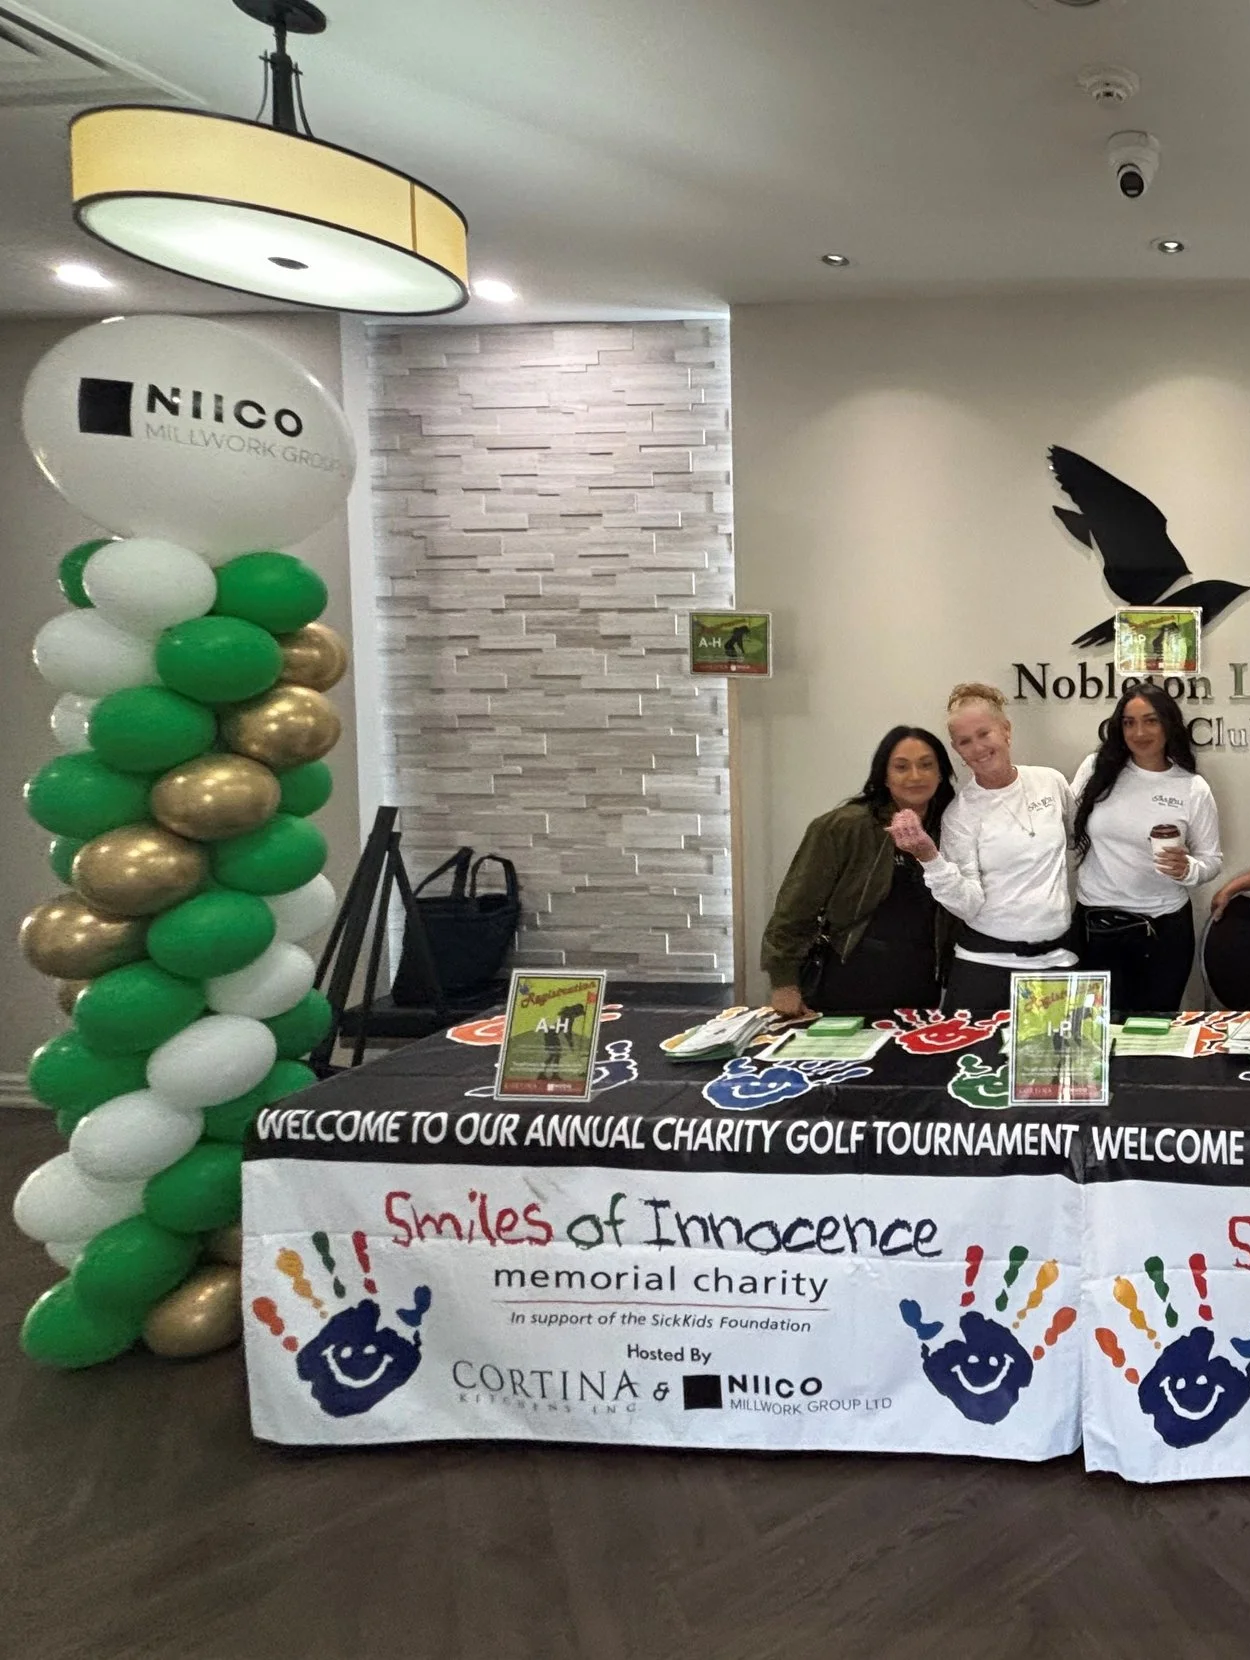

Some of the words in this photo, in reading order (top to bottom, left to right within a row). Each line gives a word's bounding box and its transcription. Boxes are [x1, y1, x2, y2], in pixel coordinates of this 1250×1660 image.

[146, 383, 304, 438] NIICO
[145, 422, 277, 458] MILLWORK
[698, 637, 722, 648] A-H
[535, 1018, 570, 1034] A-H
[256, 1108, 408, 1143] WELCOME
[411, 1111, 449, 1144] TO
[454, 1112, 521, 1146] OUR
[524, 1114, 645, 1149] ANNUAL
[652, 1117, 783, 1153] CHARITY
[785, 1120, 867, 1154] GOLF
[872, 1121, 1079, 1158] TOURNAMENT
[1092, 1126, 1245, 1166] WELCOME
[385, 1188, 554, 1247] Smiles
[567, 1192, 627, 1250] of
[638, 1196, 943, 1257] Innocence
[494, 1266, 676, 1290] memorial
[693, 1267, 829, 1303] charity
[511, 1312, 525, 1324] In
[530, 1312, 593, 1331] support
[598, 1312, 618, 1325] of
[621, 1313, 647, 1326] the
[651, 1313, 714, 1329] SickKids
[719, 1316, 812, 1333] Foundation
[627, 1344, 684, 1362] Hosted
[690, 1348, 712, 1365] By
[453, 1360, 640, 1401] CORTINA
[653, 1381, 671, 1401] &
[728, 1374, 824, 1399] NIICO
[730, 1398, 802, 1416] MILLWORK
[807, 1399, 862, 1413] GROUP
[865, 1397, 893, 1411] LTD
